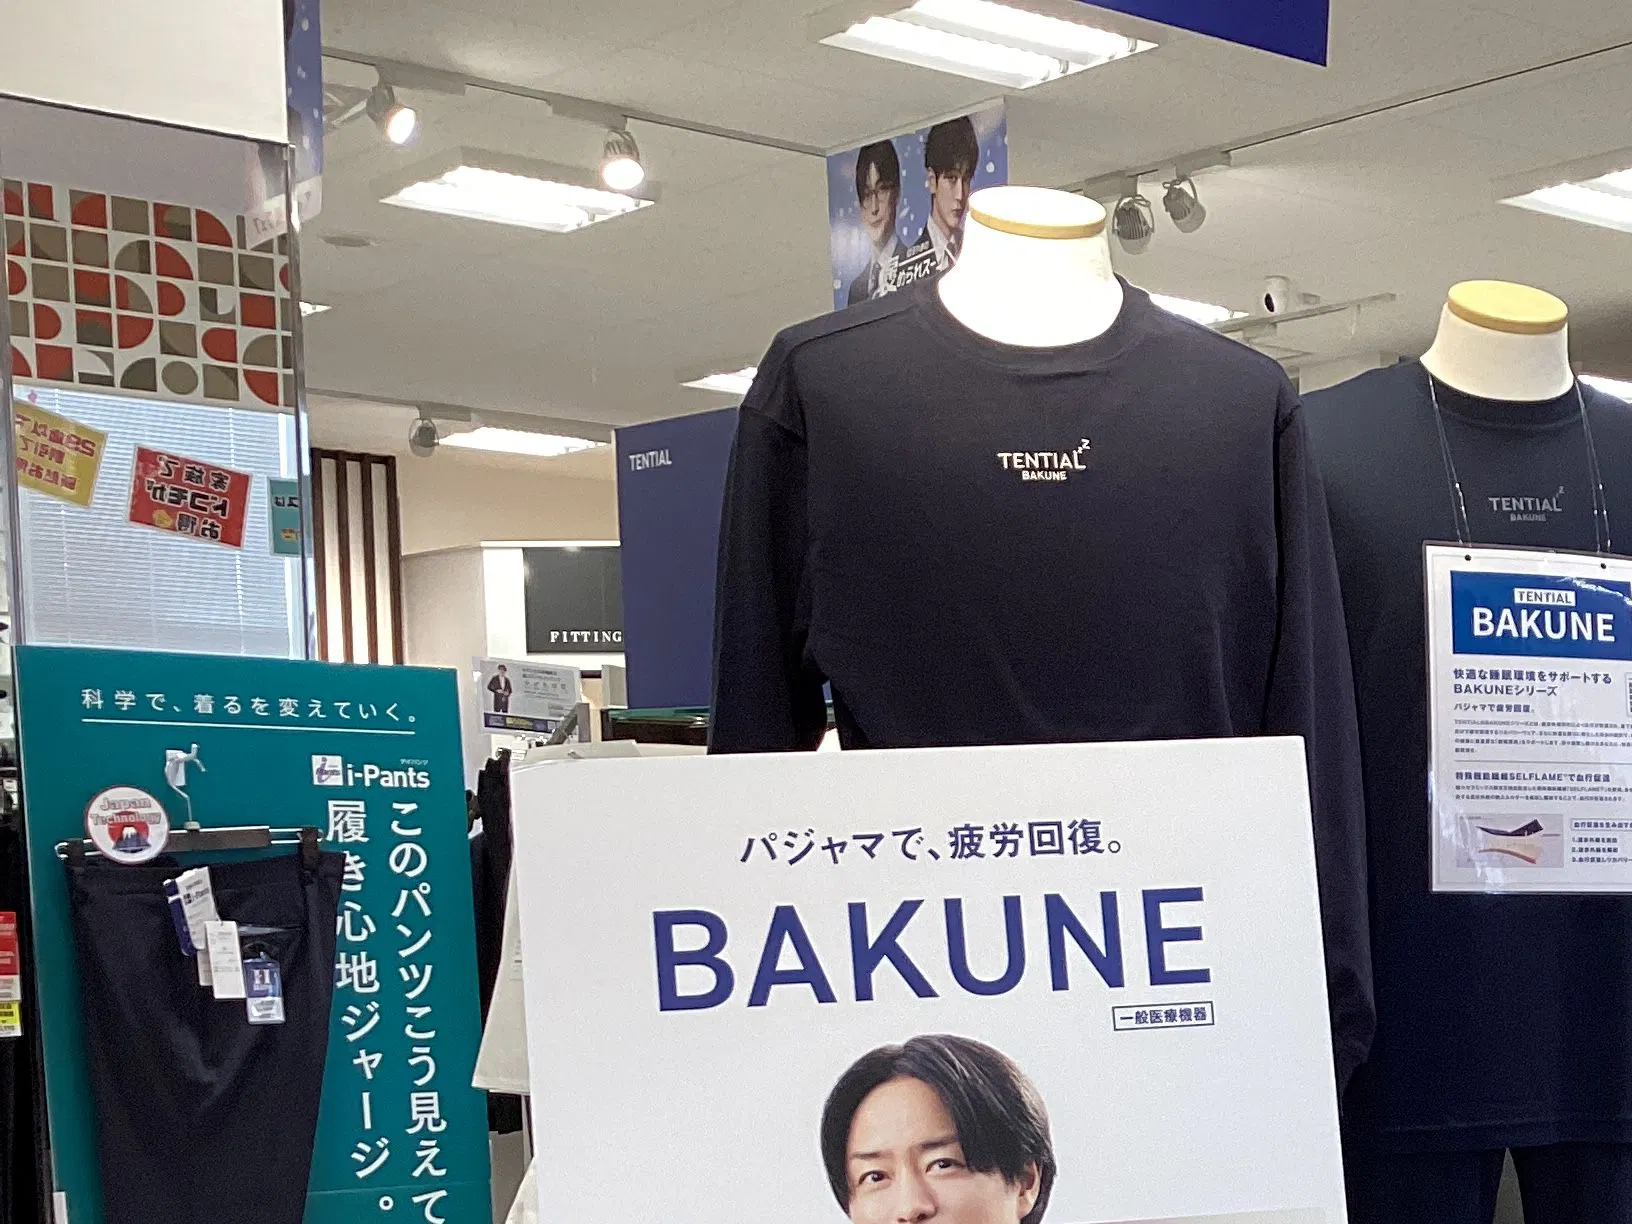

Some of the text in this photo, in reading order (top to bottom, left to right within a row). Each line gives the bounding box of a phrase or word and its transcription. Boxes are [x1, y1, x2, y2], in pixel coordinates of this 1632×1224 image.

[629, 449, 672, 471] TENTIAL
[997, 450, 1087, 470] TENTIAL
[1022, 470, 1067, 480] BAKUNE
[1488, 497, 1562, 512] TENTIAL
[1510, 513, 1546, 521] BAKUNE
[1518, 590, 1572, 605] TENTIAL
[1472, 607, 1616, 643] BAKUNE
[550, 630, 622, 643] FITTING
[1453, 668, 1612, 684] 快適な睡眠環境をサポートする
[1453, 683, 1558, 696] BAKUNEシリーズ
[81, 688, 417, 724] 科学で、着るを変えていく。
[347, 763, 431, 788] i-Pants
[101, 797, 151, 811] Japan
[90, 812, 162, 826] Technology
[740, 818, 1122, 865] パジャマで、疲労回復。
[652, 886, 1212, 1012] BAKUNE
[1120, 1007, 1207, 1024] 一般医療機器
